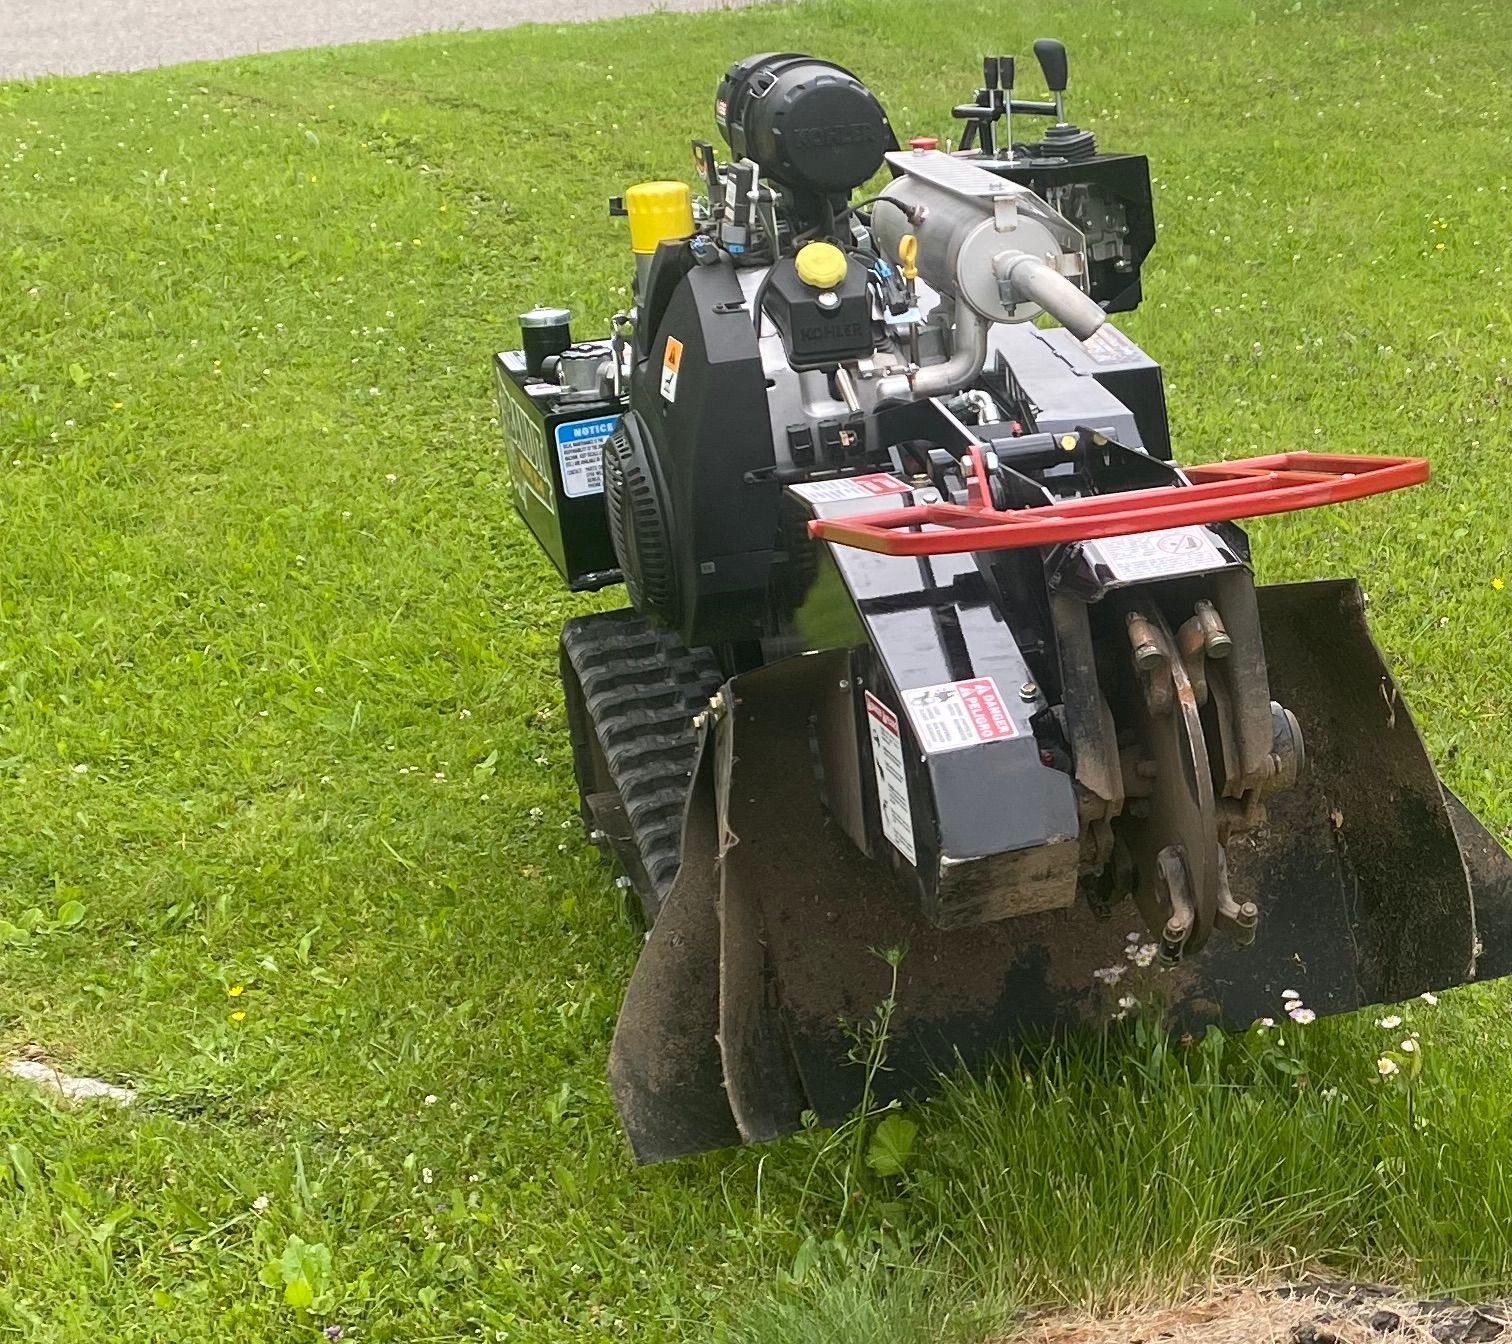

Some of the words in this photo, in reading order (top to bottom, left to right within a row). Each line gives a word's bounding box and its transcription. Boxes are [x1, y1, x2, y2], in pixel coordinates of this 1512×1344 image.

[793, 120, 874, 148] KOHLER
[801, 321, 864, 341] KOHLER
[573, 422, 614, 437] NOTICE
[967, 696, 994, 737] PELIGRO
[983, 694, 1010, 734] DANGER
